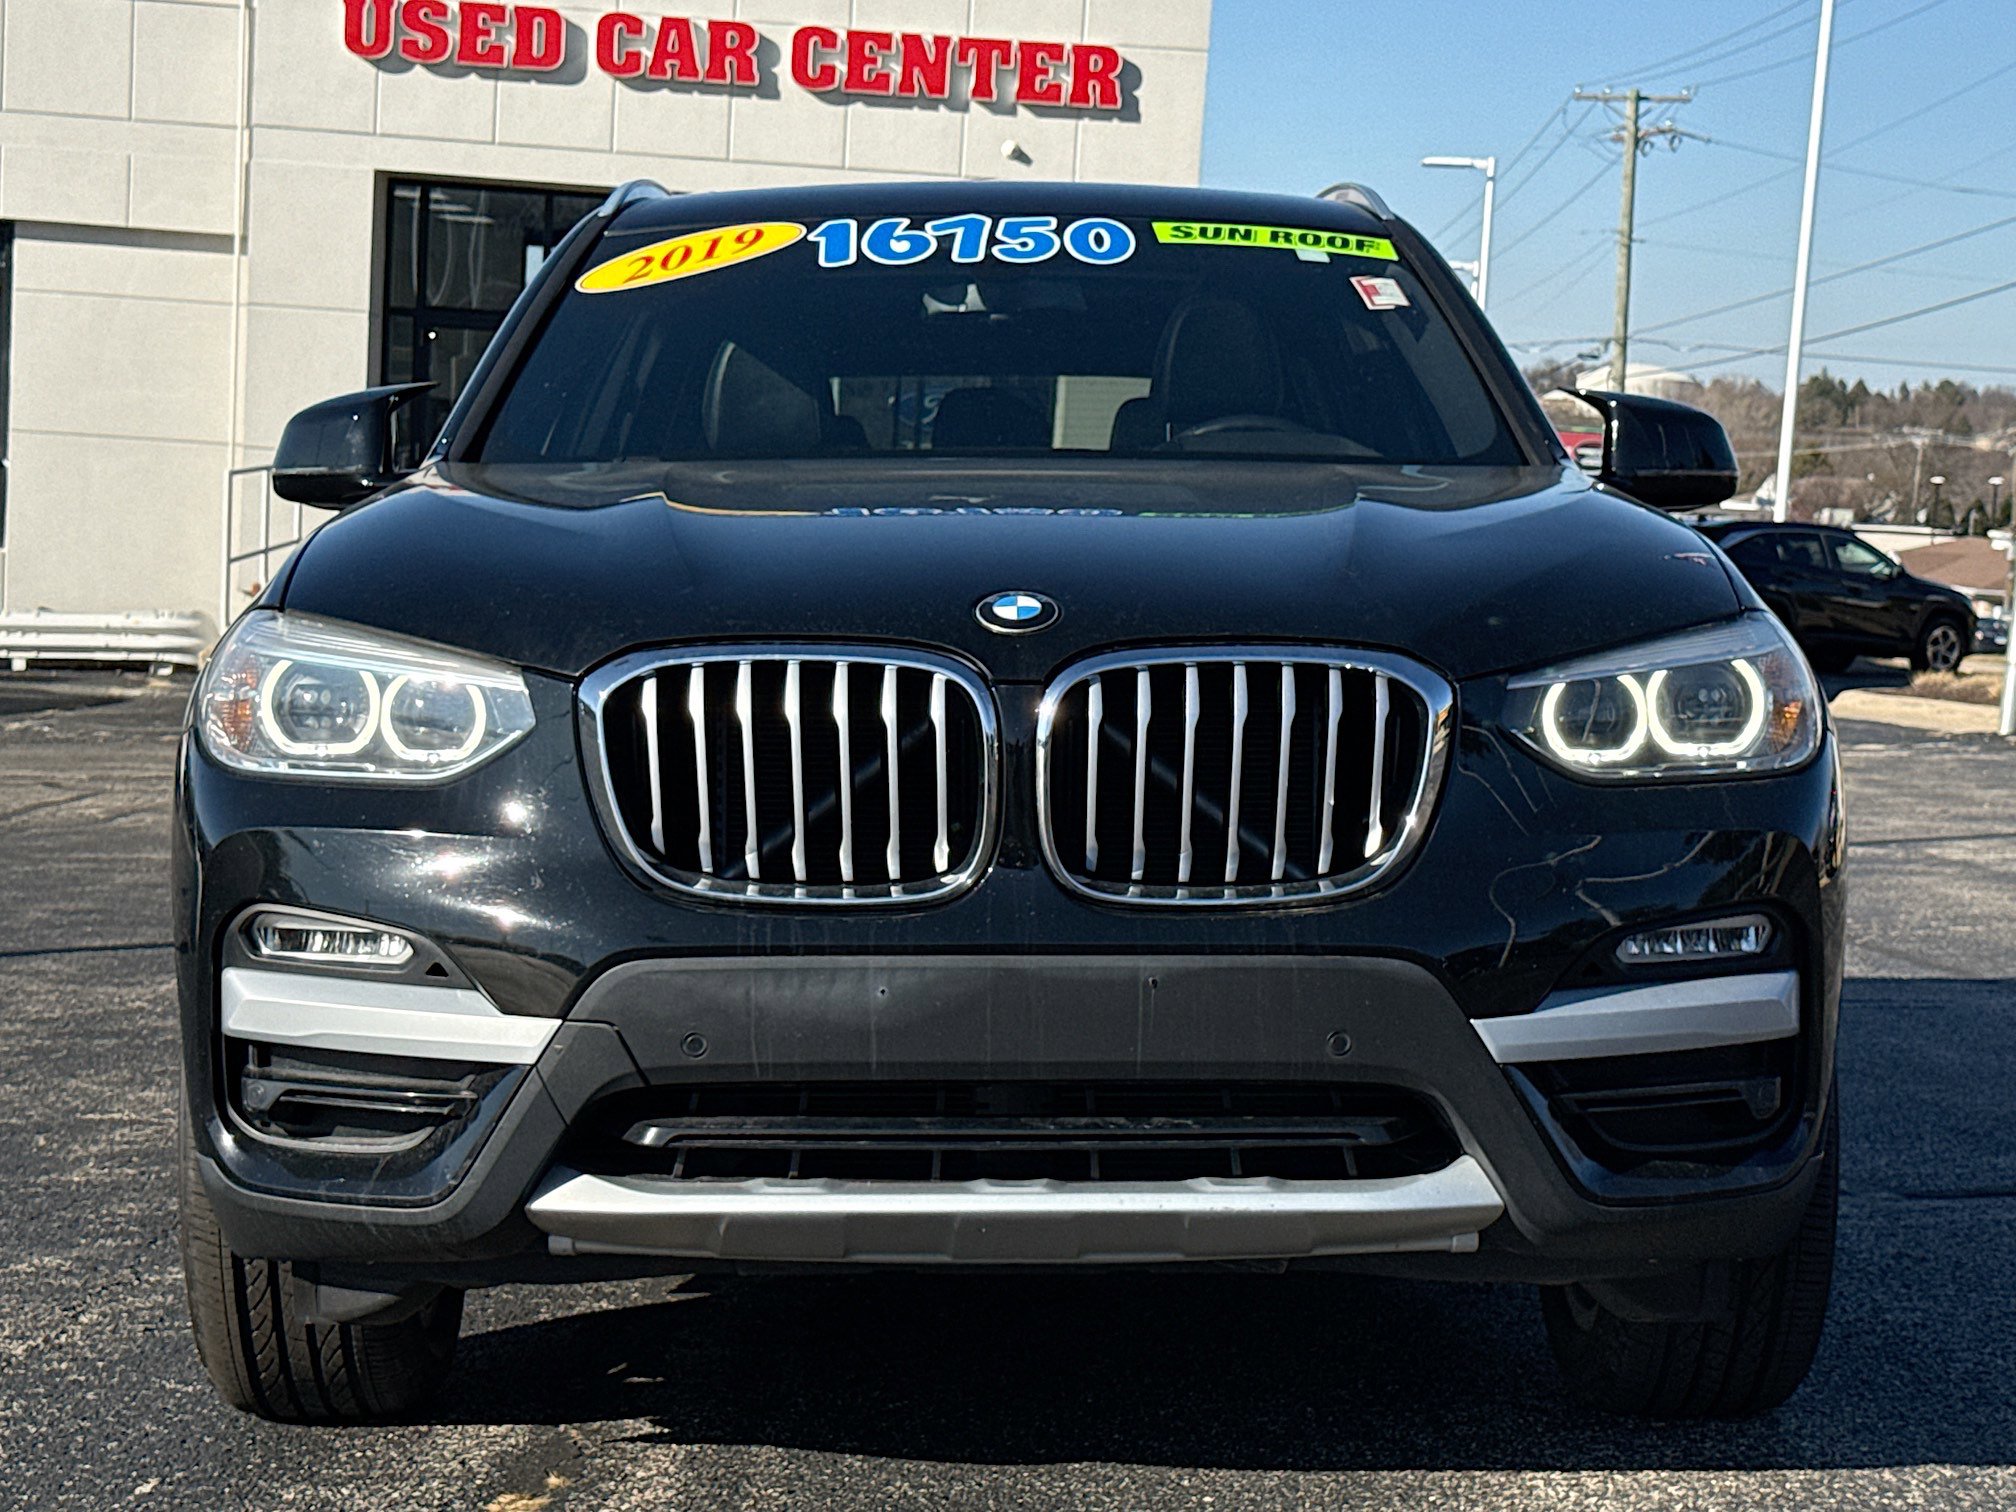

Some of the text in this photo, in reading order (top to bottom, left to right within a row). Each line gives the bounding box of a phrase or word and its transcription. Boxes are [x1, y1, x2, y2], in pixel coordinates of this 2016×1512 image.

[343, 0, 1124, 108] USED CAR CENTER
[622, 226, 763, 283] 2019
[808, 214, 1136, 267] 16750
[1169, 225, 1381, 253] SUN ROOF
